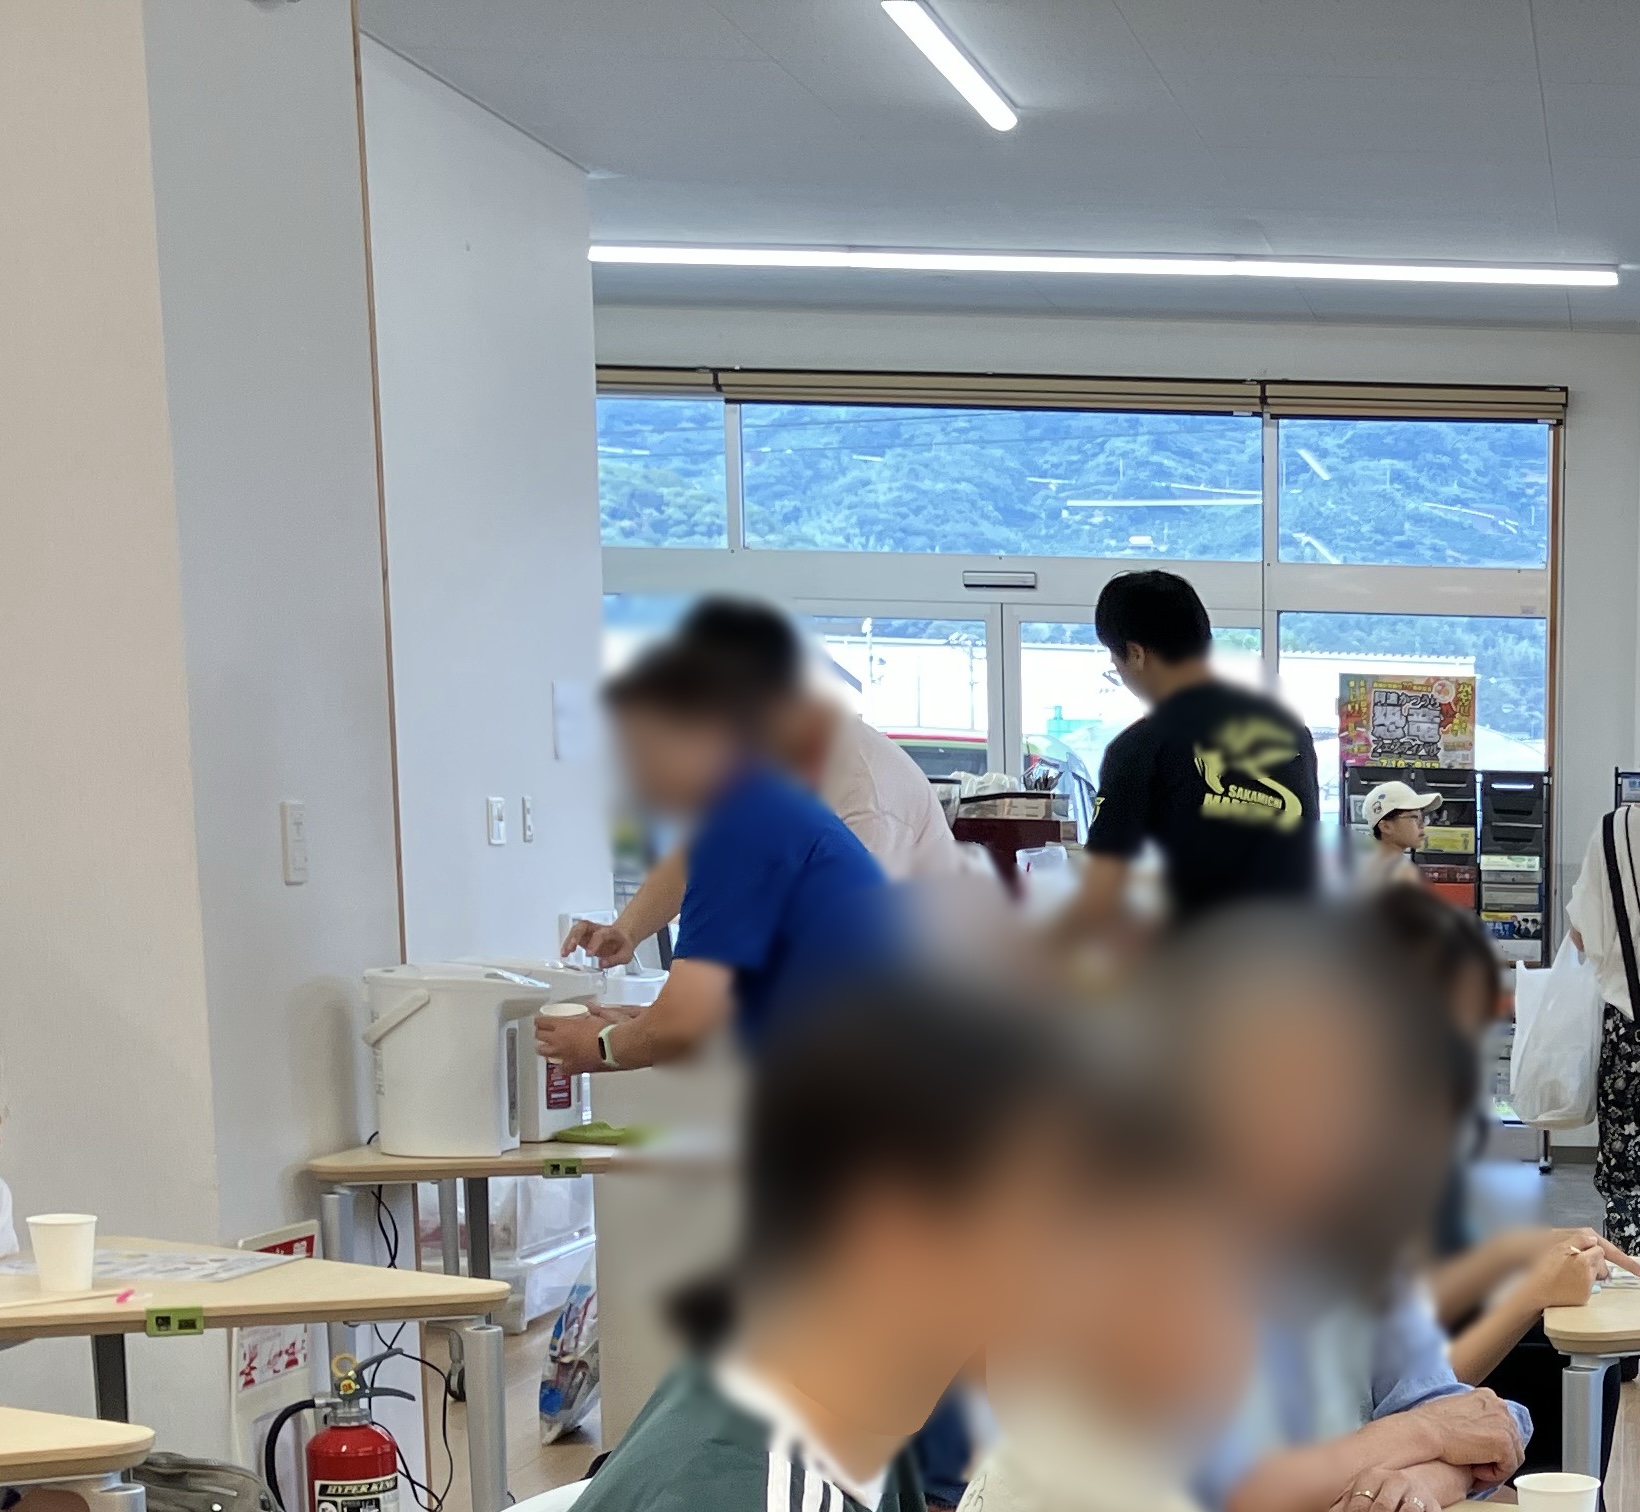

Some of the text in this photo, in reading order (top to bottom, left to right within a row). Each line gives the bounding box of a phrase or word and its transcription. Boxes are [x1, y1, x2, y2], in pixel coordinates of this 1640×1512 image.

[1228, 784, 1283, 809] SAKAMICHI
[326, 1479, 396, 1495] HYPER KING
